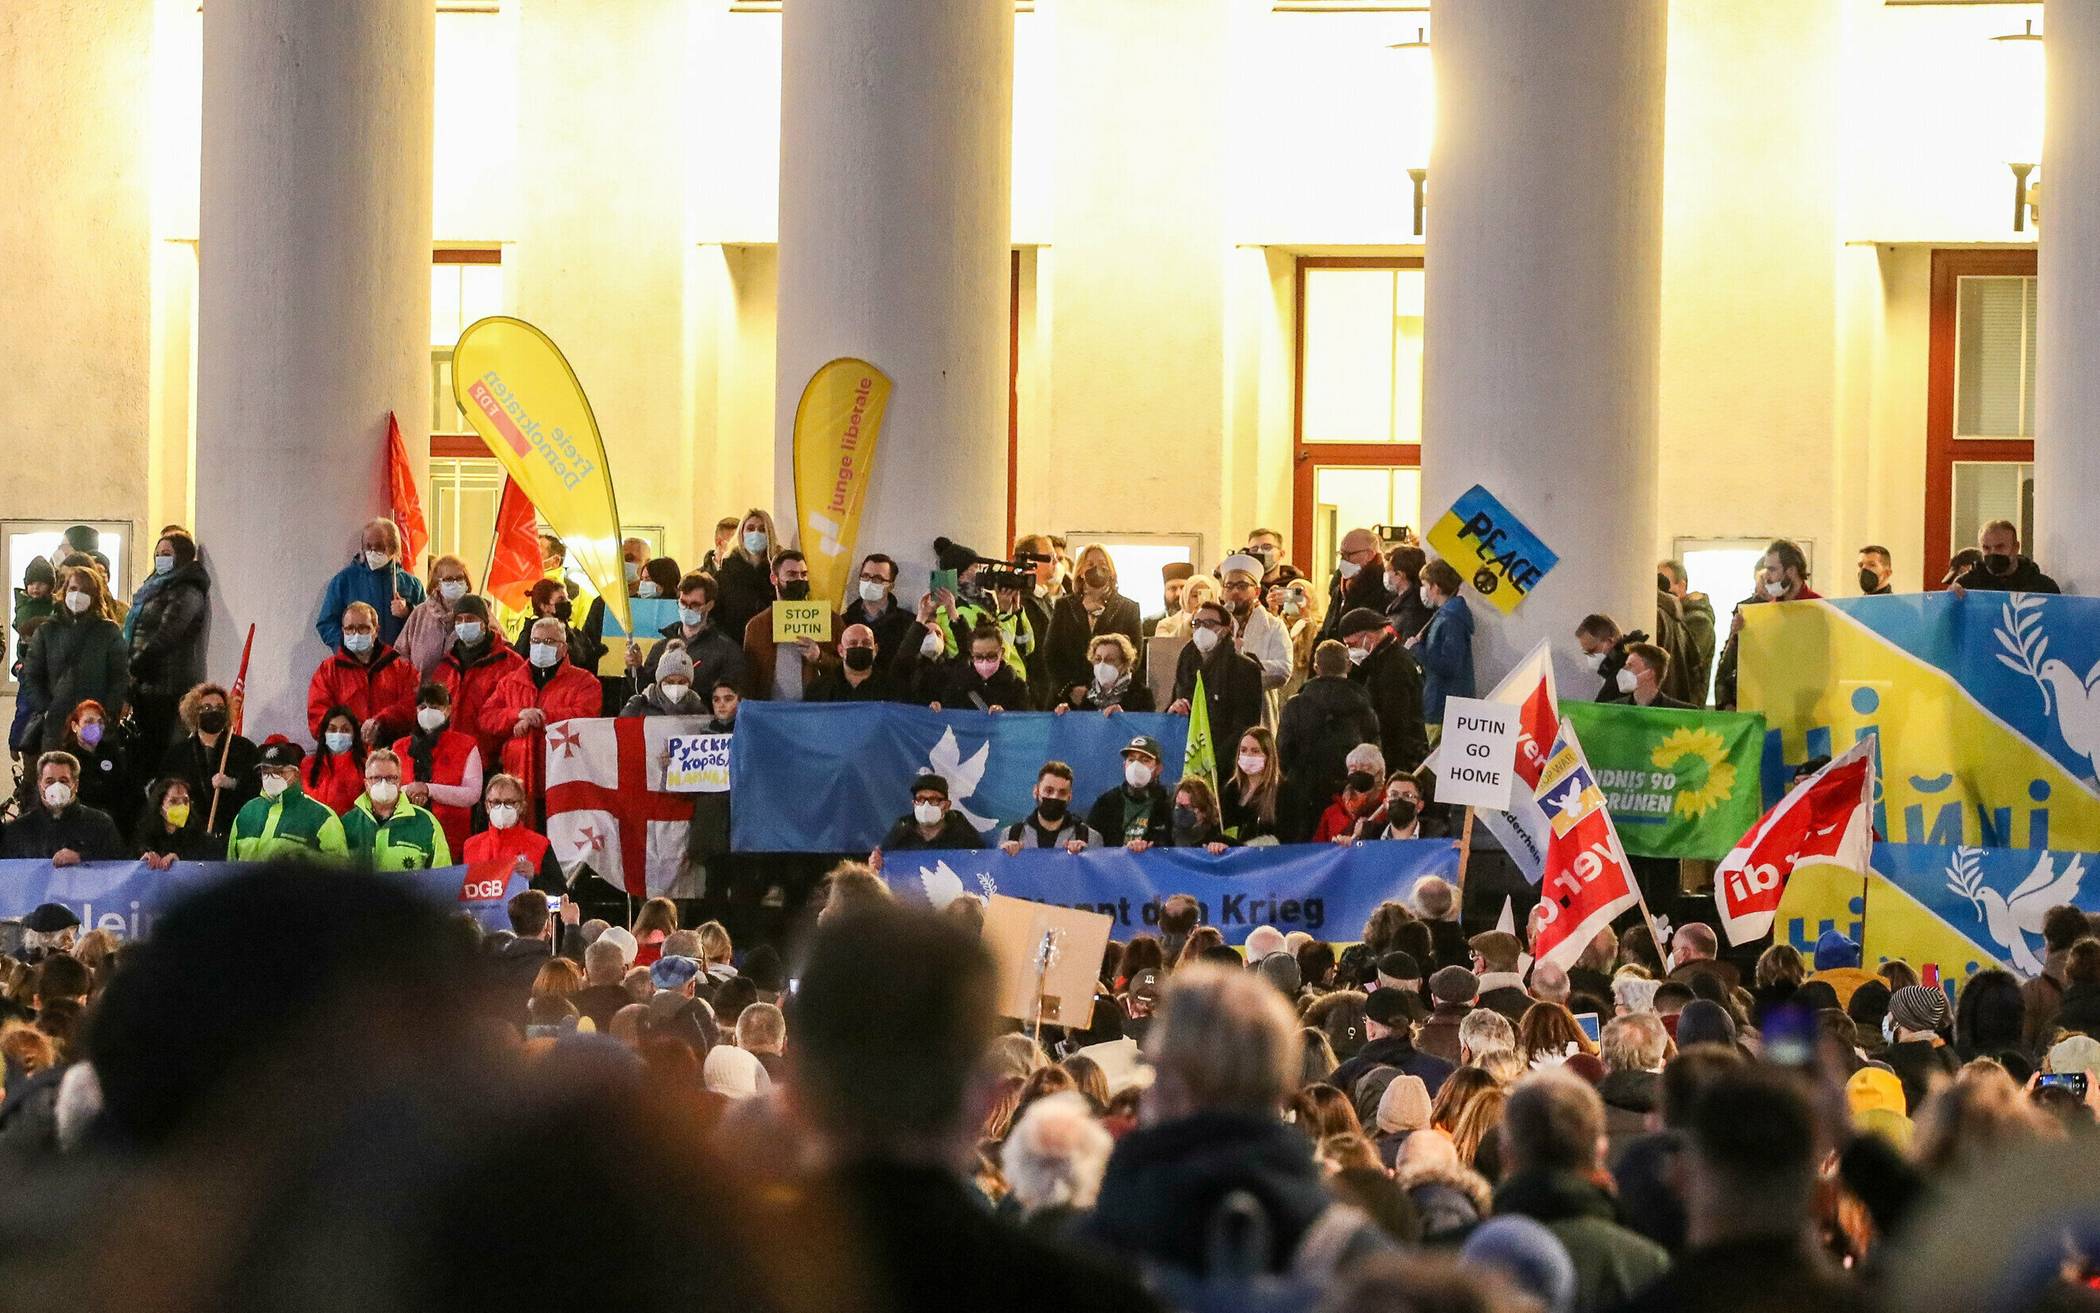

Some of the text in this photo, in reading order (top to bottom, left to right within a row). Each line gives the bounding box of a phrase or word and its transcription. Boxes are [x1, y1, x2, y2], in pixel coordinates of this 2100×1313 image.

[828, 377, 872, 516] junge liberale
[1457, 511, 1542, 596] PEACE
[785, 608, 820, 620] STOP
[784, 623, 821, 634] PUTIN
[1457, 716, 1505, 735] PUTIN
[669, 737, 731, 761] Русски
[1466, 743, 1490, 758] GO
[682, 753, 729, 772] кораб
[1450, 766, 1500, 786] HOME
[1591, 769, 1676, 790] NDNIS 90
[1606, 788, 1672, 813] RÜNEN
[1501, 810, 1540, 865] ederrhein
[464, 880, 503, 899] DGB
[1222, 894, 1326, 930] Krieg
